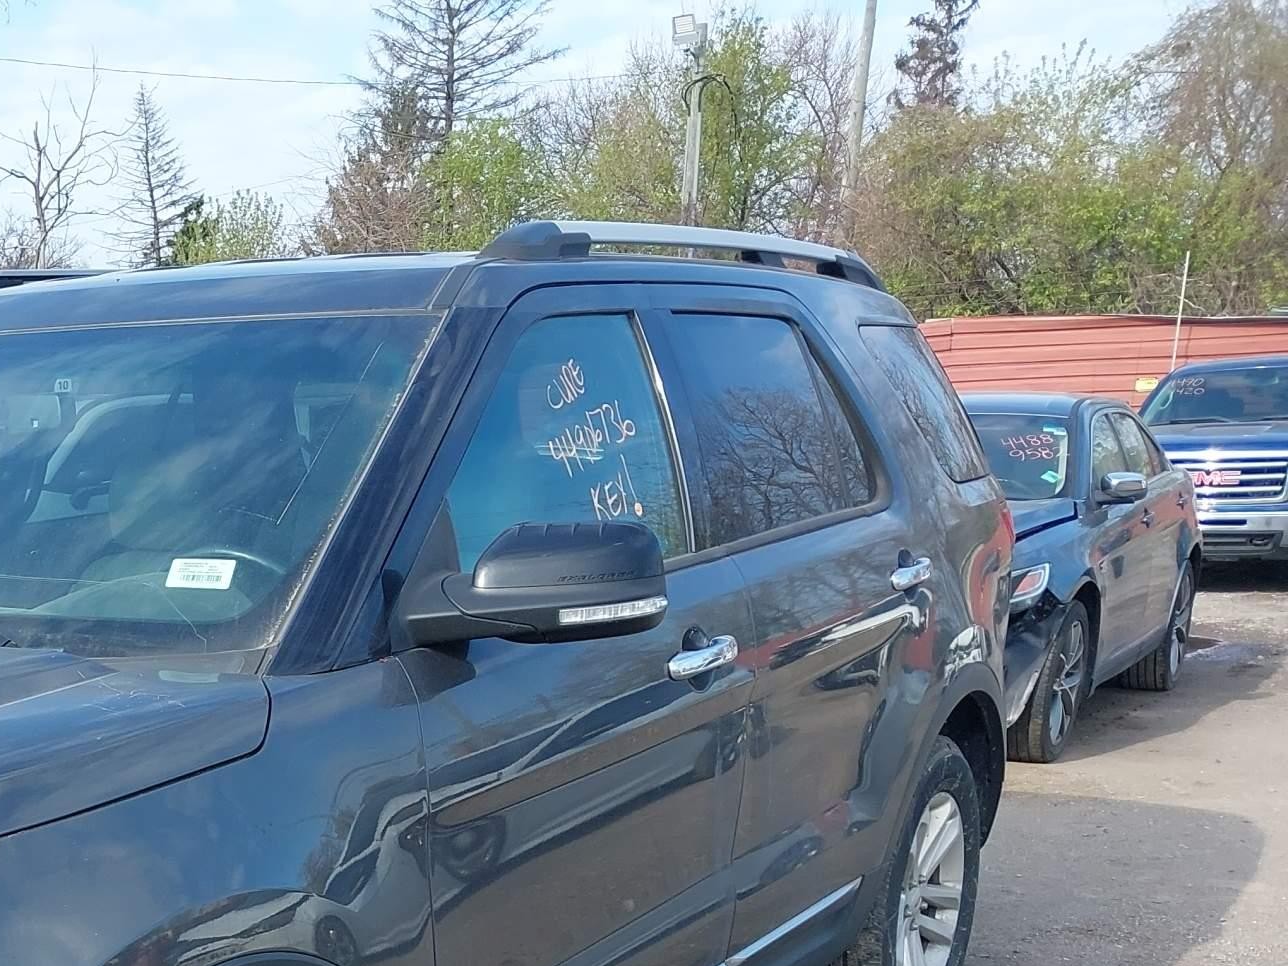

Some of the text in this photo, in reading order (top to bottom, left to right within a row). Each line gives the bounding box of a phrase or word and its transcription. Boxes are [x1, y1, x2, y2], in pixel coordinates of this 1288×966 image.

[1000, 433, 1054, 450] 4488
[1191, 470, 1241, 486] MC
[590, 453, 643, 521] KEY!
